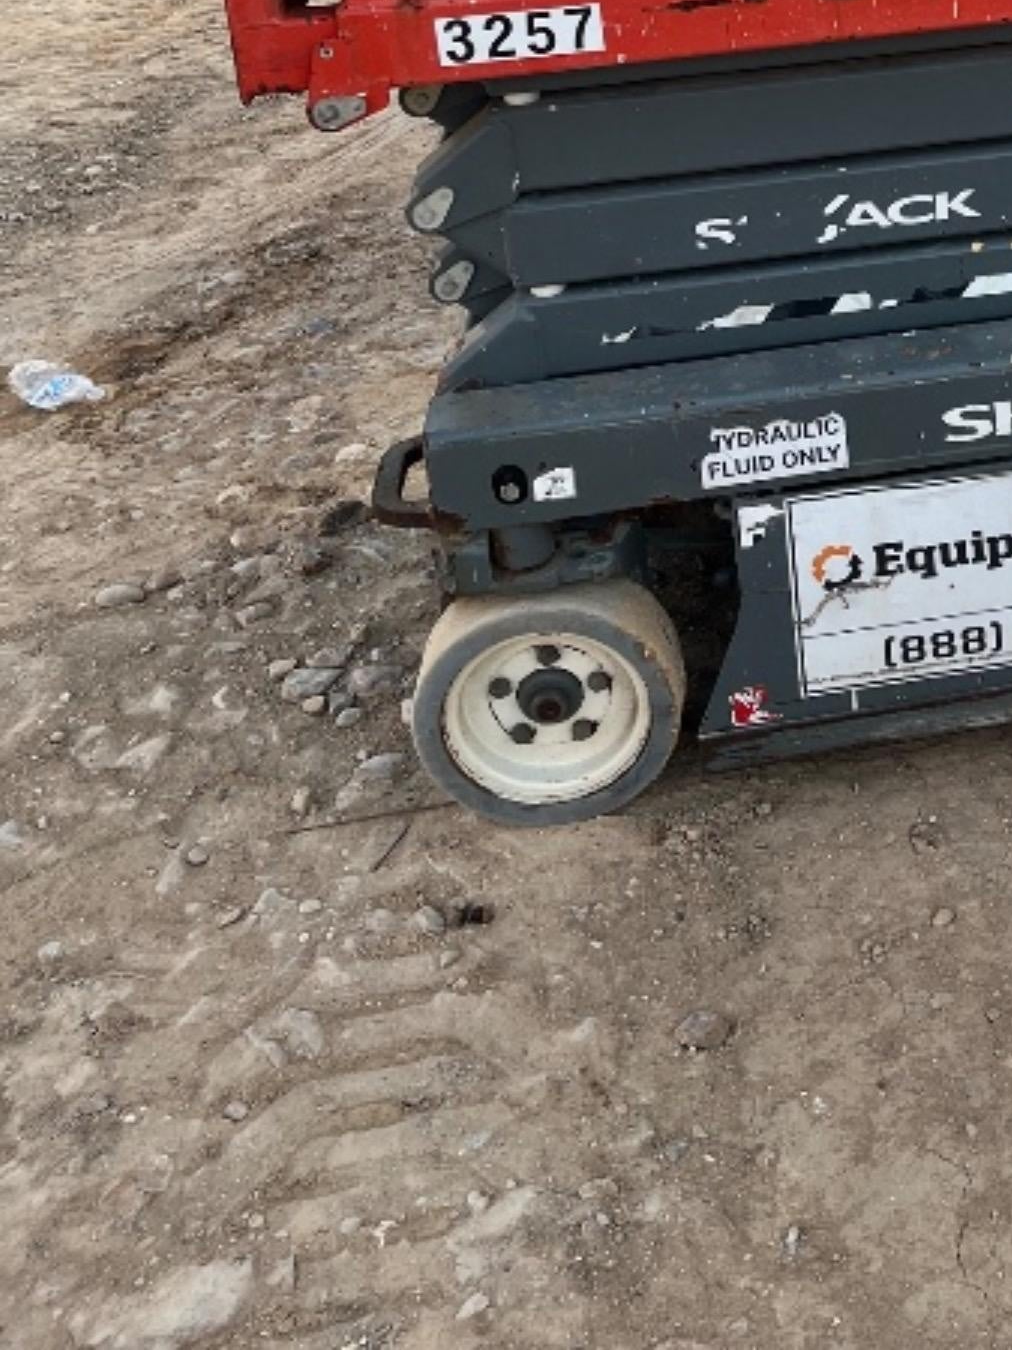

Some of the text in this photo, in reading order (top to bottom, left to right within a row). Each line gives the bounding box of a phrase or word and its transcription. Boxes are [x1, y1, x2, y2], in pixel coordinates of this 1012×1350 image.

[444, 6, 593, 64] 3257
[708, 444, 841, 480] FLUID ONLY
[884, 621, 1002, 667] (888)
